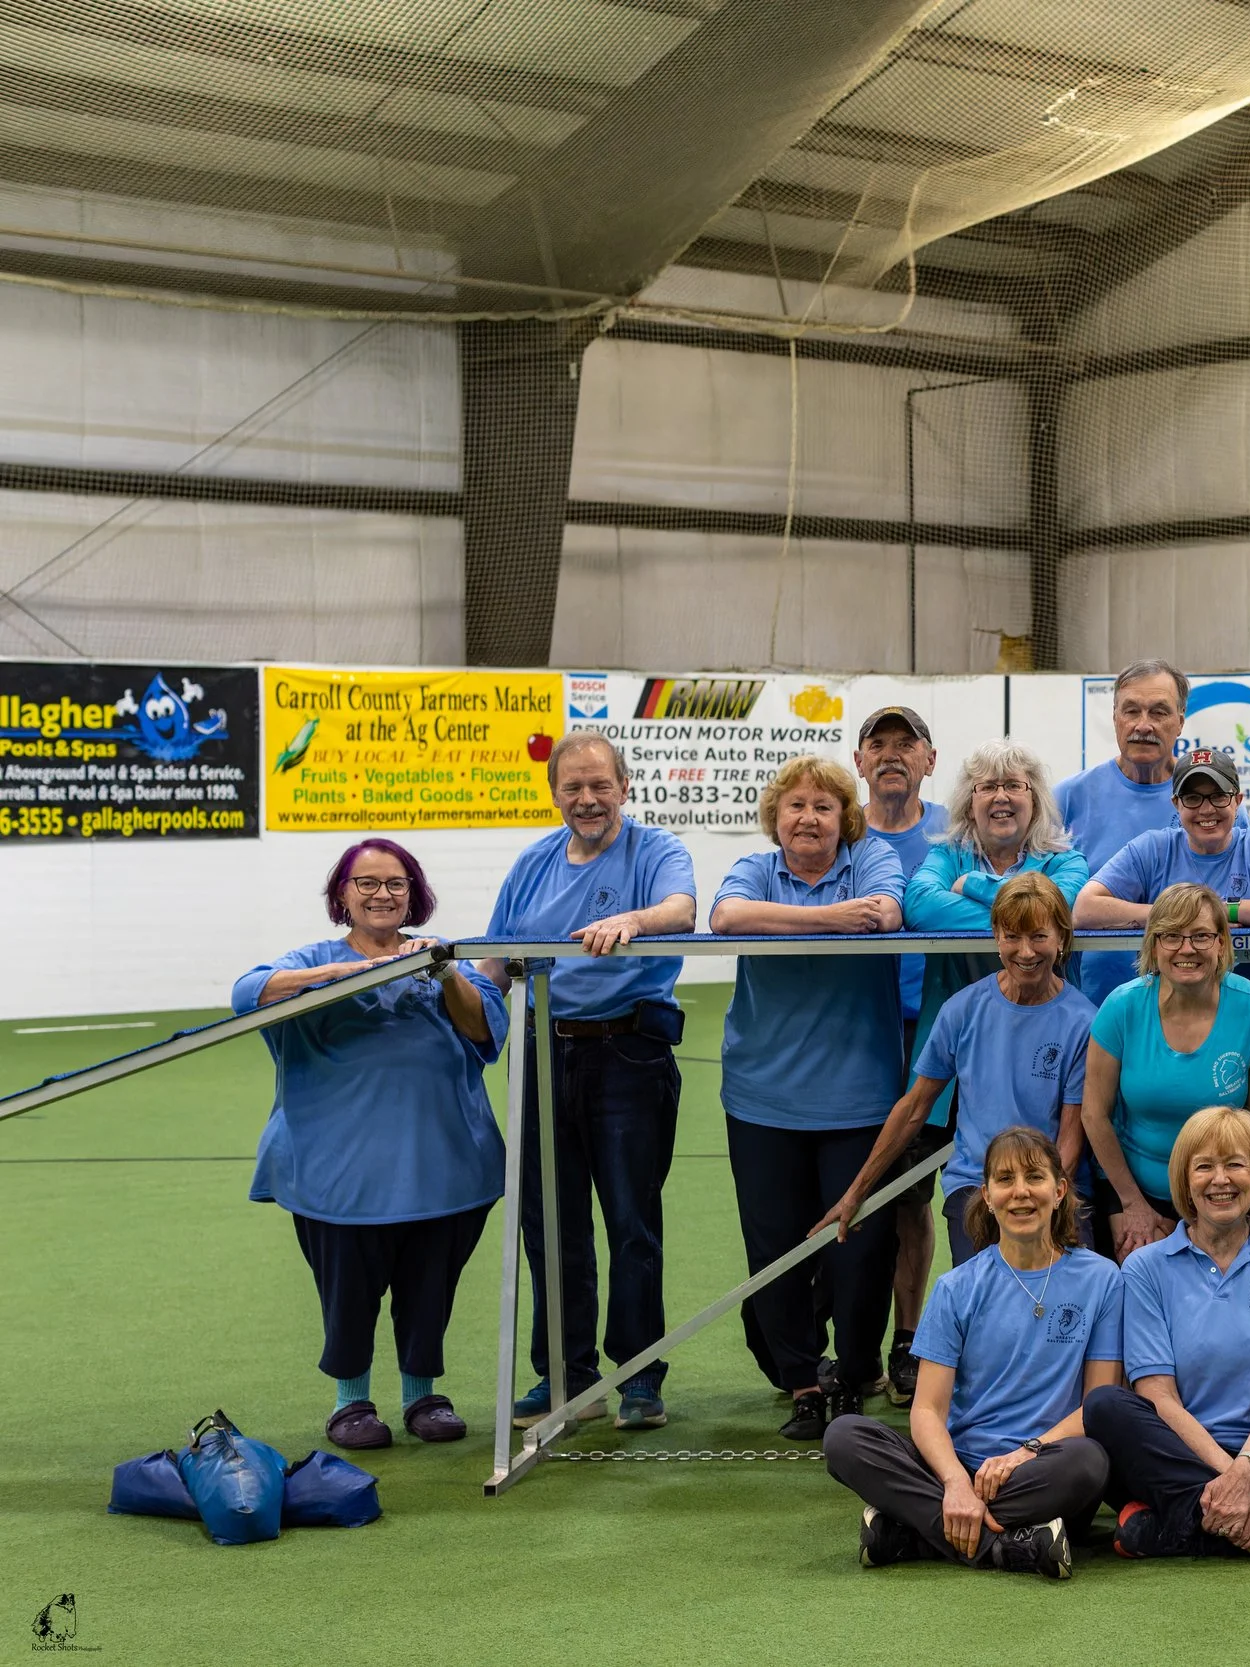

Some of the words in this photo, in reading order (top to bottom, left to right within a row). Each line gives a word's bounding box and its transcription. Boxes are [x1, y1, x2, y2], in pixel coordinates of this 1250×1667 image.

[570, 681, 606, 692] BOSCH
[275, 681, 342, 711] Carroll
[347, 683, 413, 720] County
[420, 685, 488, 713] Farmers
[494, 686, 552, 713] Market
[571, 693, 606, 702] Service
[664, 680, 765, 719] RMW
[345, 720, 363, 742] at
[369, 715, 397, 742] the
[403, 715, 428, 750] Ag
[434, 716, 490, 742] Center
[697, 726, 763, 742] MOTOR
[770, 728, 843, 743] WORKS
[0, 739, 53, 757] Pools
[71, 740, 117, 762] Spas
[312, 751, 348, 764] BUY
[354, 750, 408, 765] LOCAL
[432, 749, 464, 764] EAT
[470, 750, 521, 764] FRESH
[632, 746, 699, 762] Service
[704, 747, 747, 762] Auto
[1173, 737, 1236, 762] Be
[1191, 751, 1212, 765] H
[5, 764, 86, 785] Aboveground
[88, 764, 116, 780] Pool
[118, 764, 128, 780] &
[130, 764, 153, 783] Spa
[155, 765, 186, 780] Sales
[188, 765, 199, 780] &
[200, 764, 245, 781] Service.
[300, 767, 347, 784] Fruits
[364, 768, 455, 787] Vegetables
[471, 767, 531, 783] Flowers
[627, 768, 645, 780] OR
[651, 769, 662, 781] A
[668, 768, 707, 781] FREE
[713, 768, 750, 781] TIRE
[38, 785, 67, 800] Best
[68, 785, 97, 800] Pool
[98, 785, 108, 800] &
[110, 785, 133, 804] Spa
[135, 785, 172, 800] Dealer
[174, 785, 203, 800] since
[206, 784, 239, 800] 1999.
[293, 788, 346, 805] Plants
[362, 788, 414, 804] Baked
[420, 787, 474, 803] Goods
[489, 786, 538, 802] Crafts
[0, 806, 63, 836] 6-3535
[81, 805, 244, 837] gallagherpools.com
[278, 807, 553, 826] www.carrollcountyfarmersmarket.com
